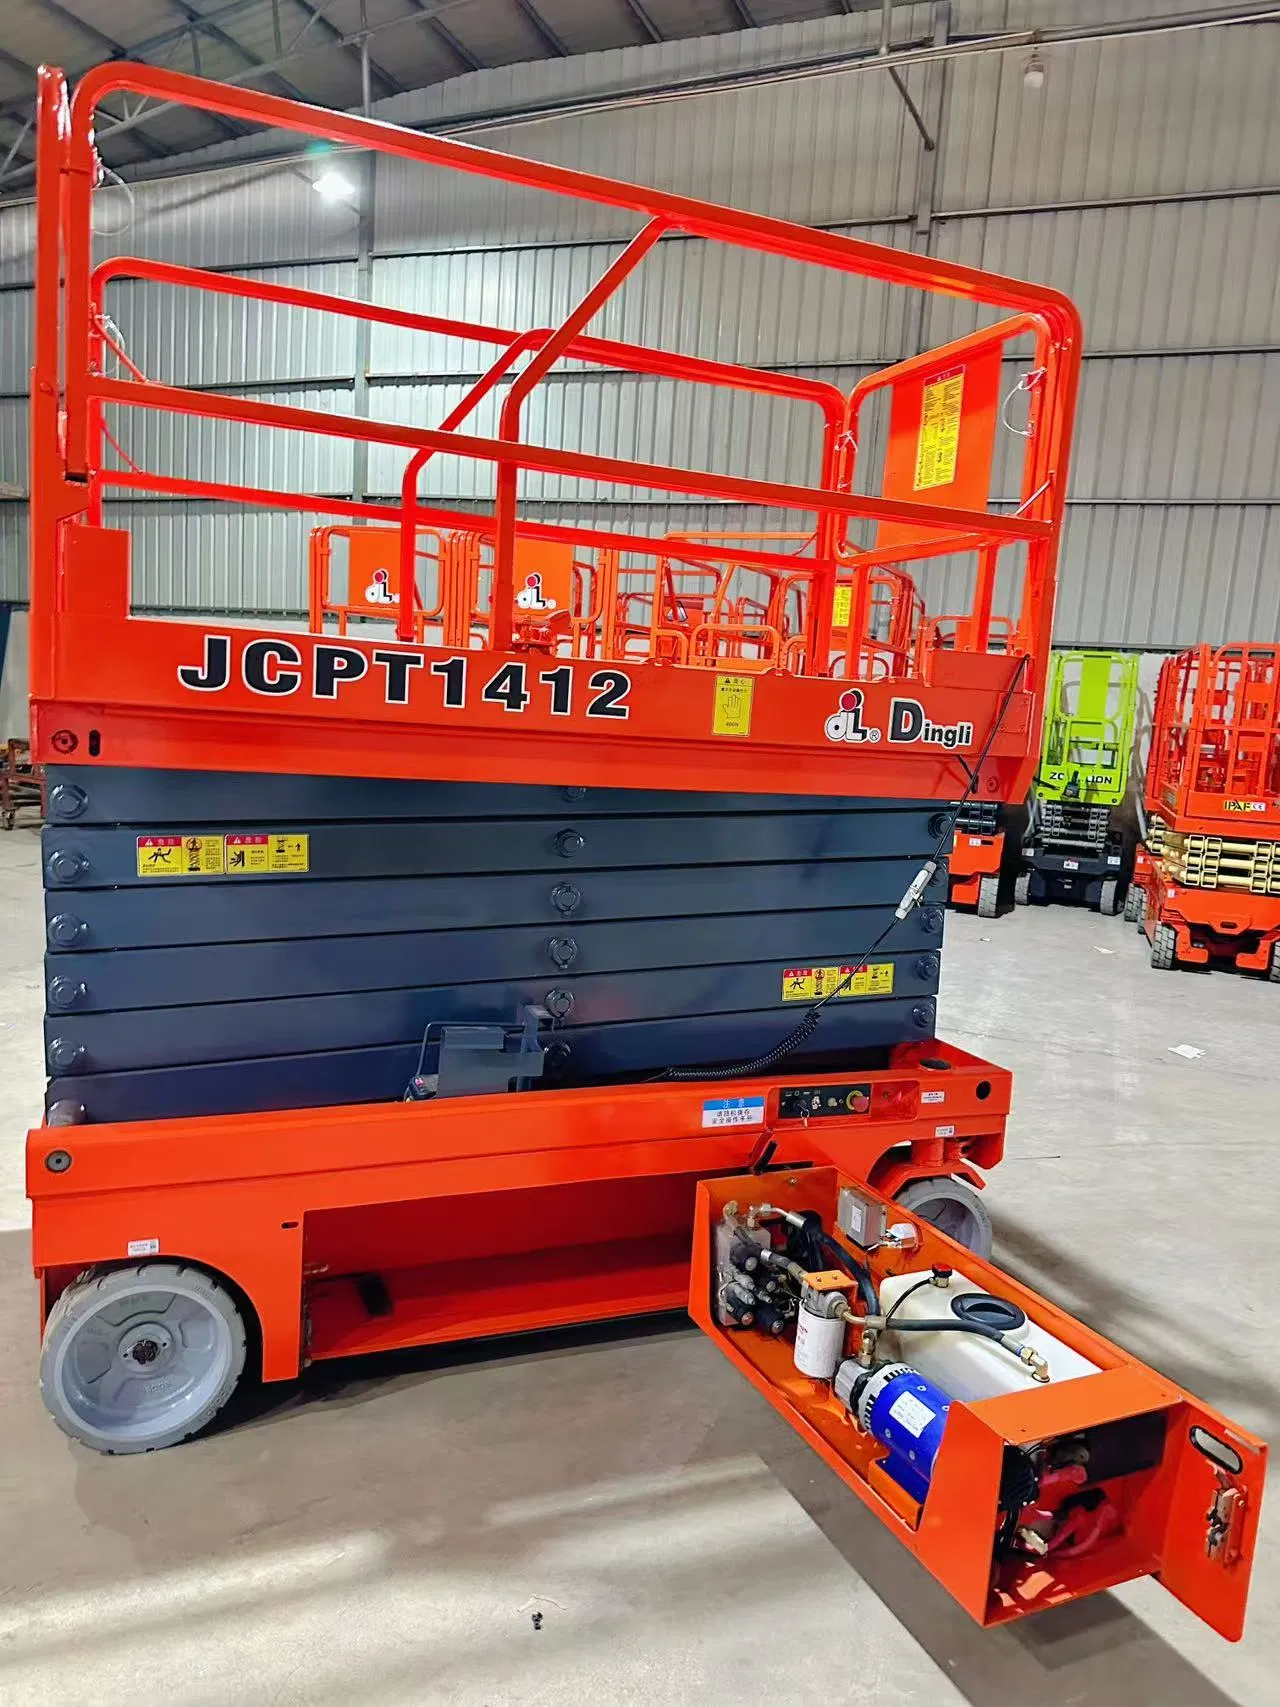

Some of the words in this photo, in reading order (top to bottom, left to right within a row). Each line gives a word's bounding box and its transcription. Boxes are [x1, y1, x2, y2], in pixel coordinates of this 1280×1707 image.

[177, 634, 632, 719] JCPT1412
[888, 697, 974, 749] Dingli
[1049, 771, 1113, 784] ZOLION
[1224, 799, 1251, 811] IPAF
